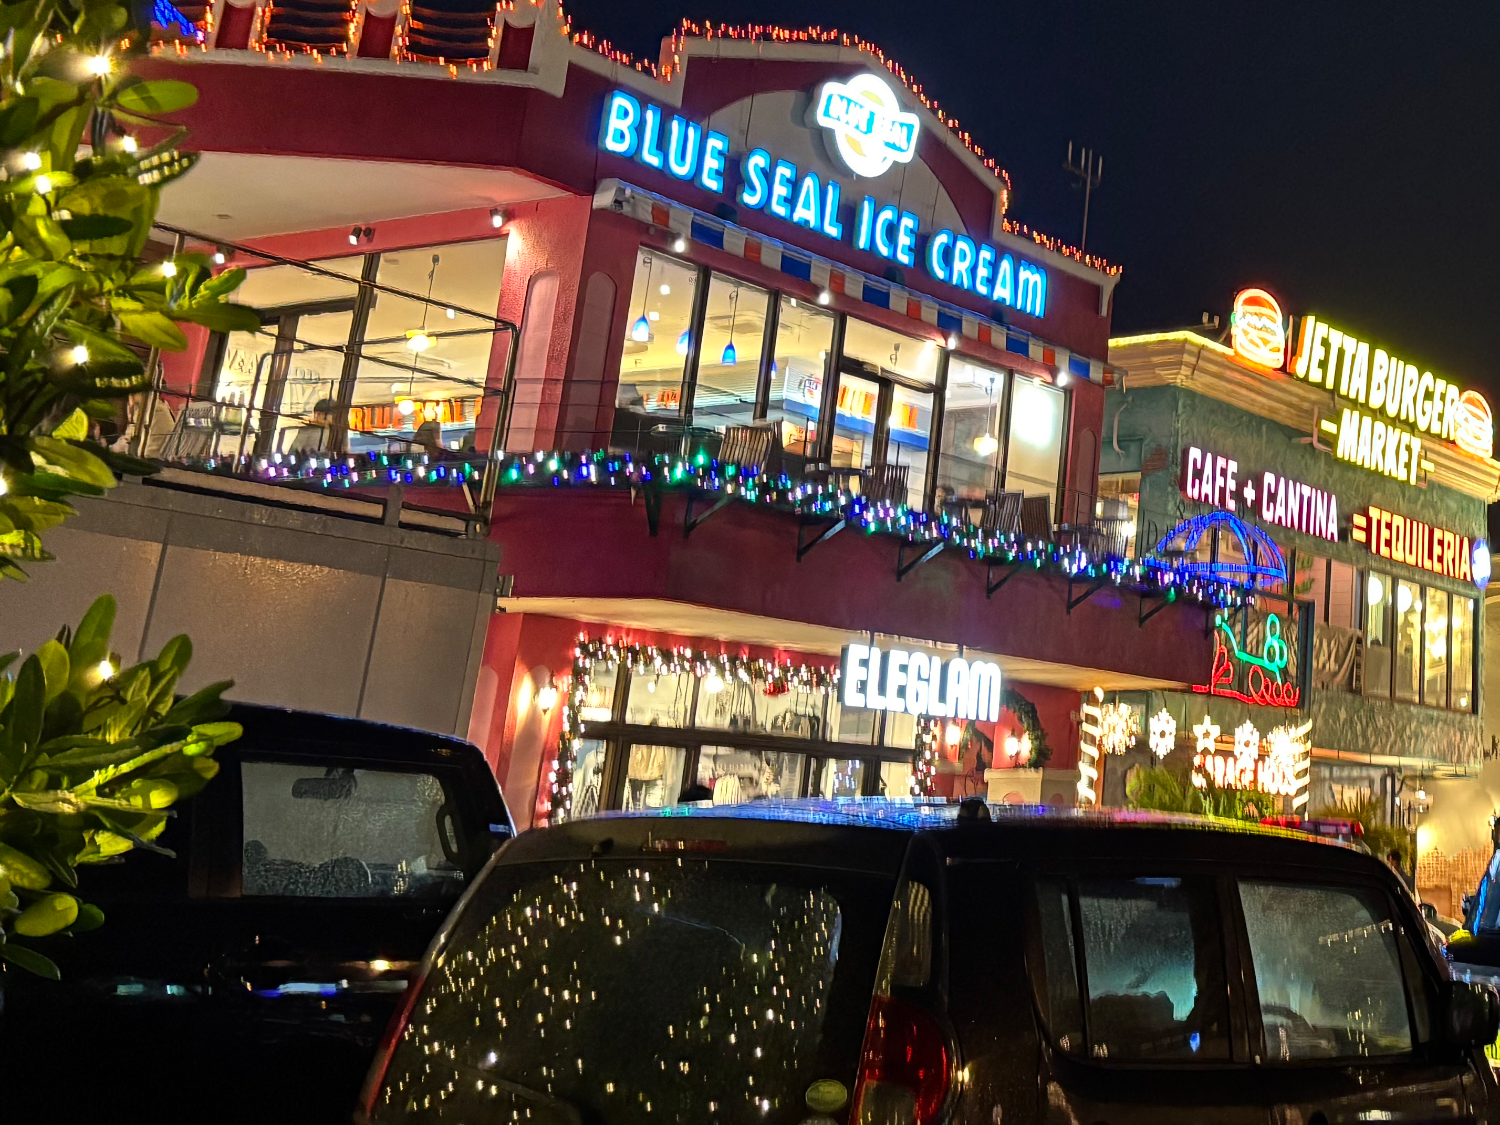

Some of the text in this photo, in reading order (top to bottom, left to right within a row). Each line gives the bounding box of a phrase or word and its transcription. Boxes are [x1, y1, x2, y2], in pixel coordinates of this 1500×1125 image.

[603, 90, 1047, 318] BLUE SEAL ICE CREAM
[1294, 315, 1463, 441] JETTA BURGER
[1336, 408, 1422, 486] MARKET
[1186, 446, 1238, 512] CAFE
[1261, 471, 1340, 543] CANTINA
[1367, 505, 1473, 582] TEQUILERIA
[843, 643, 1001, 723] ELEGLAM
